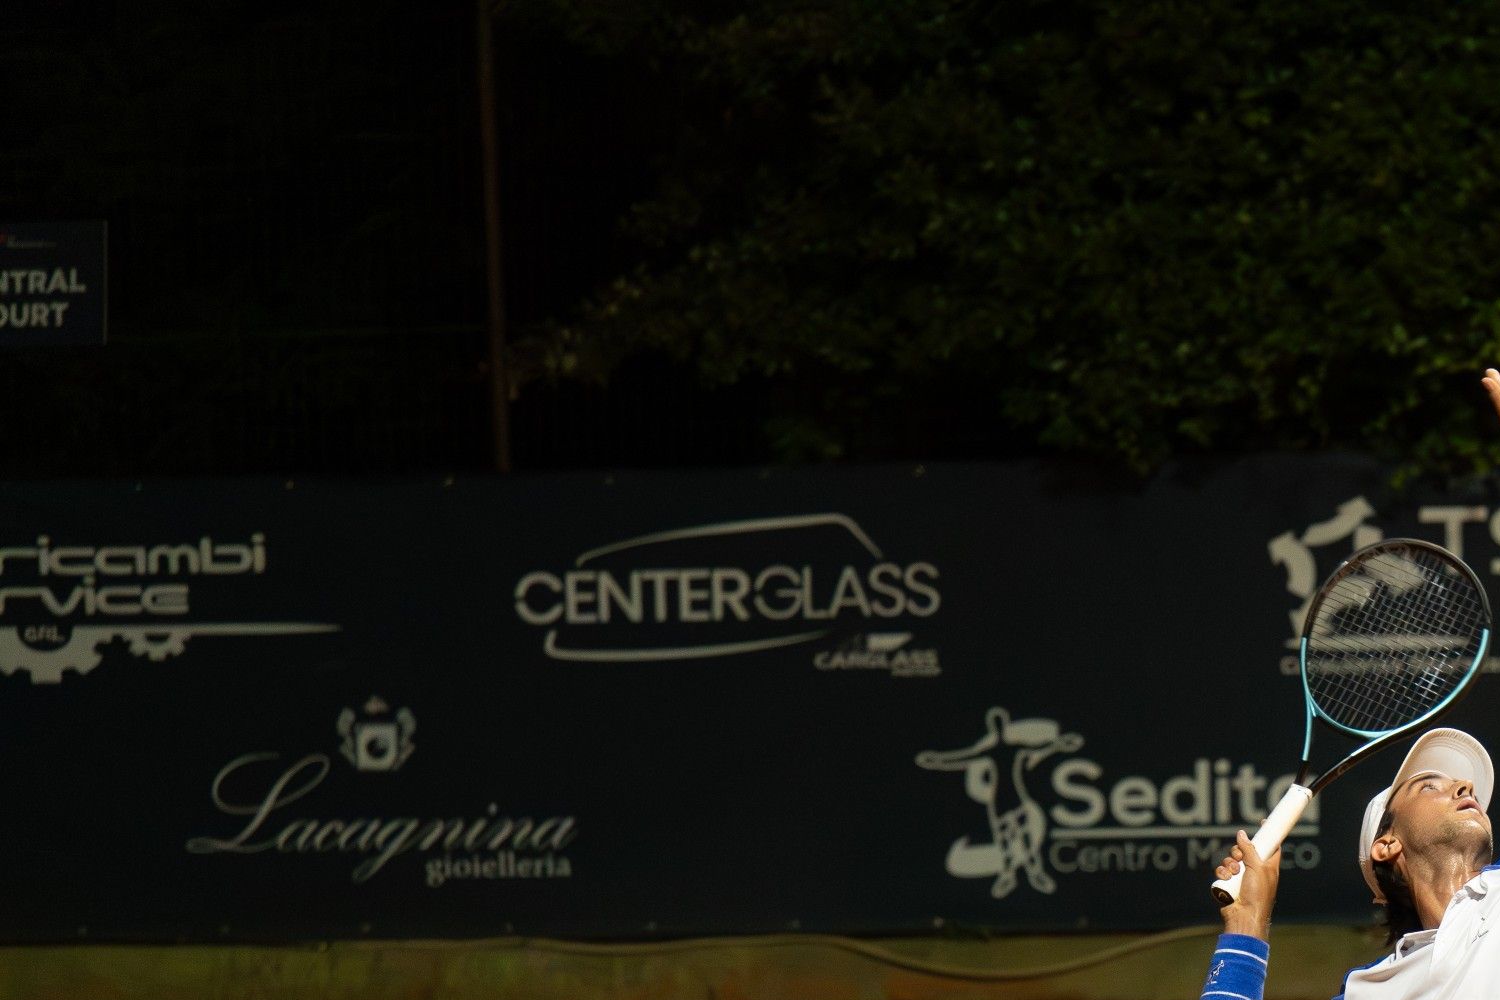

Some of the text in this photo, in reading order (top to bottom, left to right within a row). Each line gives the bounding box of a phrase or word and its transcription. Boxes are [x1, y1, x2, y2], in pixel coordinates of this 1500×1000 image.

[0, 533, 266, 576] ricambi
[515, 562, 941, 625] CENTERGLASS
[186, 753, 577, 882] Lacagnina
[426, 851, 572, 887] gioielleria
[1050, 840, 1177, 872] Centro
